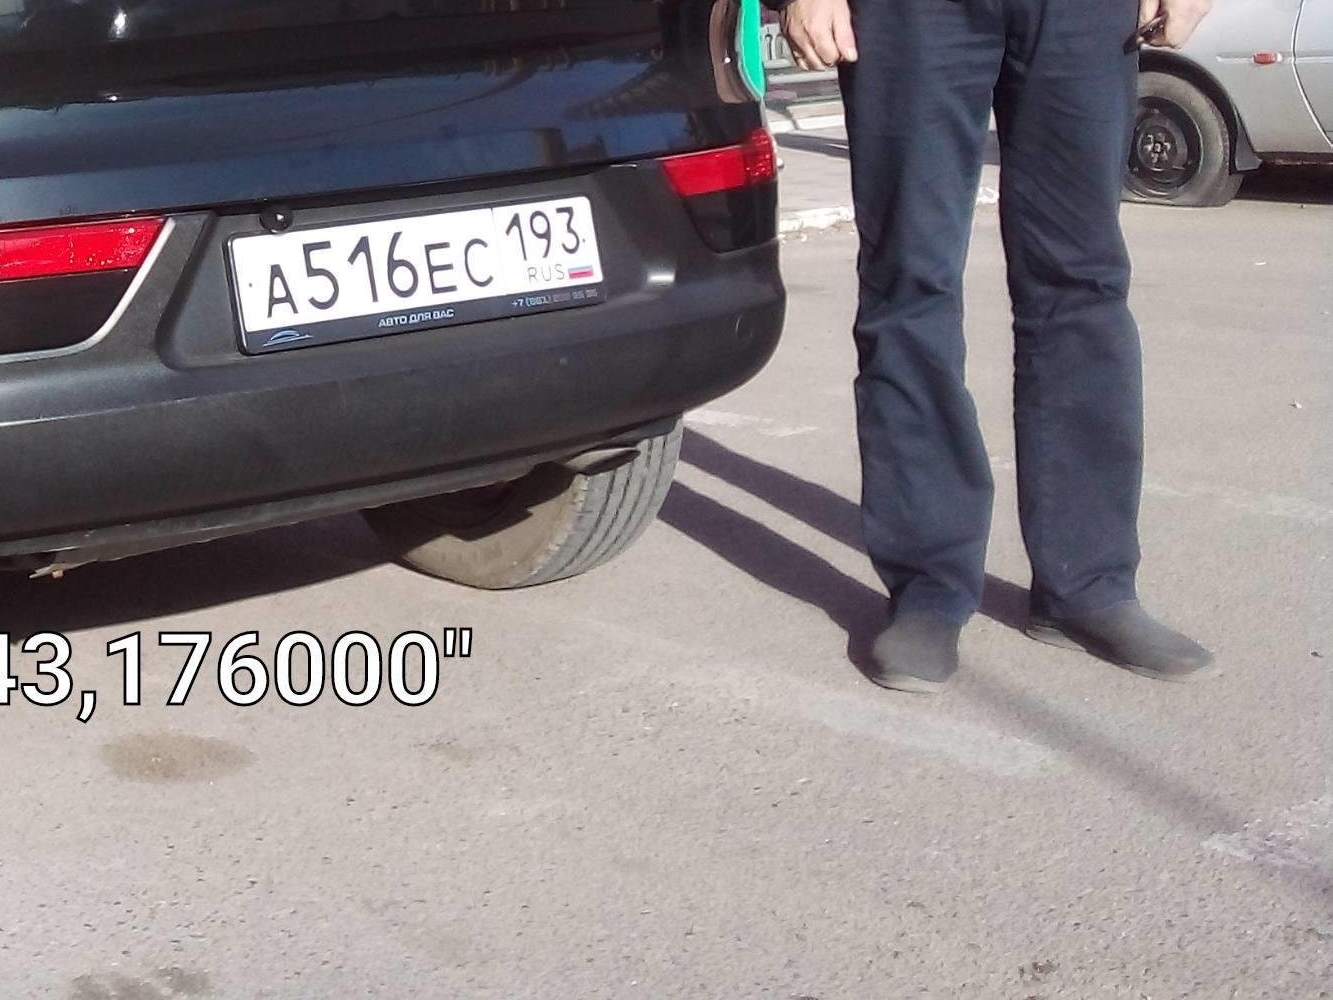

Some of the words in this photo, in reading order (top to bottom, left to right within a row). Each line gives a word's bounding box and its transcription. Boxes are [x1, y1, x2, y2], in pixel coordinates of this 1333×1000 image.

[267, 231, 494, 318] А516ЕС
[505, 206, 580, 262] 193
[527, 264, 566, 284] RUS
[378, 315, 407, 328] АВТО
[409, 311, 432, 324] ДЛЯ
[433, 308, 454, 320] ВАС
